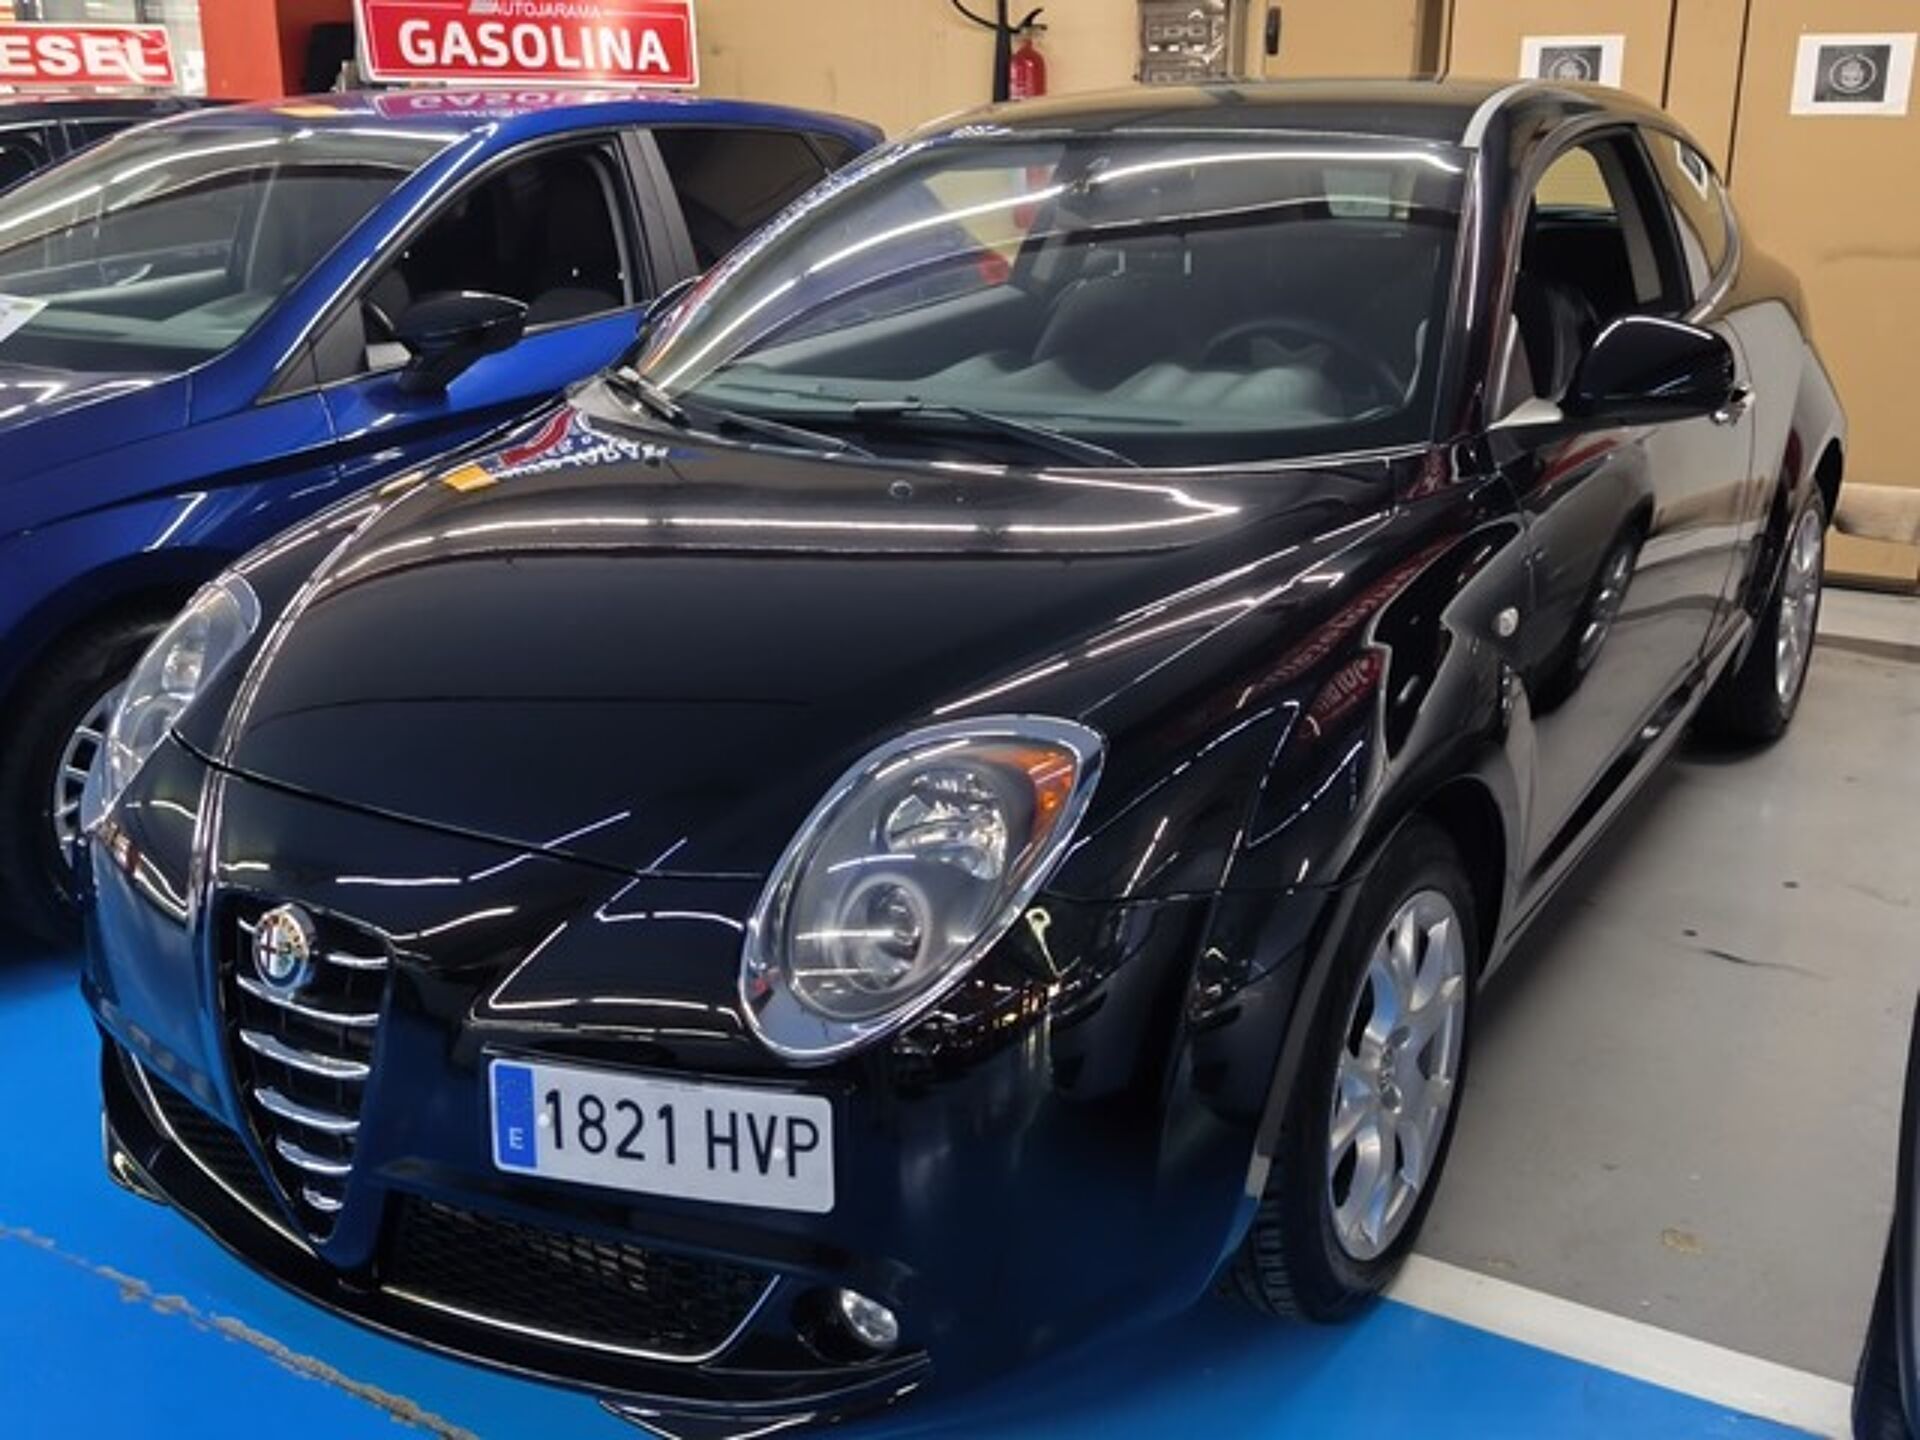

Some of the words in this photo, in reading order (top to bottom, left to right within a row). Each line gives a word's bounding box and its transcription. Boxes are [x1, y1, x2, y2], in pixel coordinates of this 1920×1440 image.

[399, 19, 671, 73] GASOLINA
[509, 1127, 524, 1151] E
[545, 1089, 676, 1166] 1821
[704, 1107, 820, 1178] HVP
